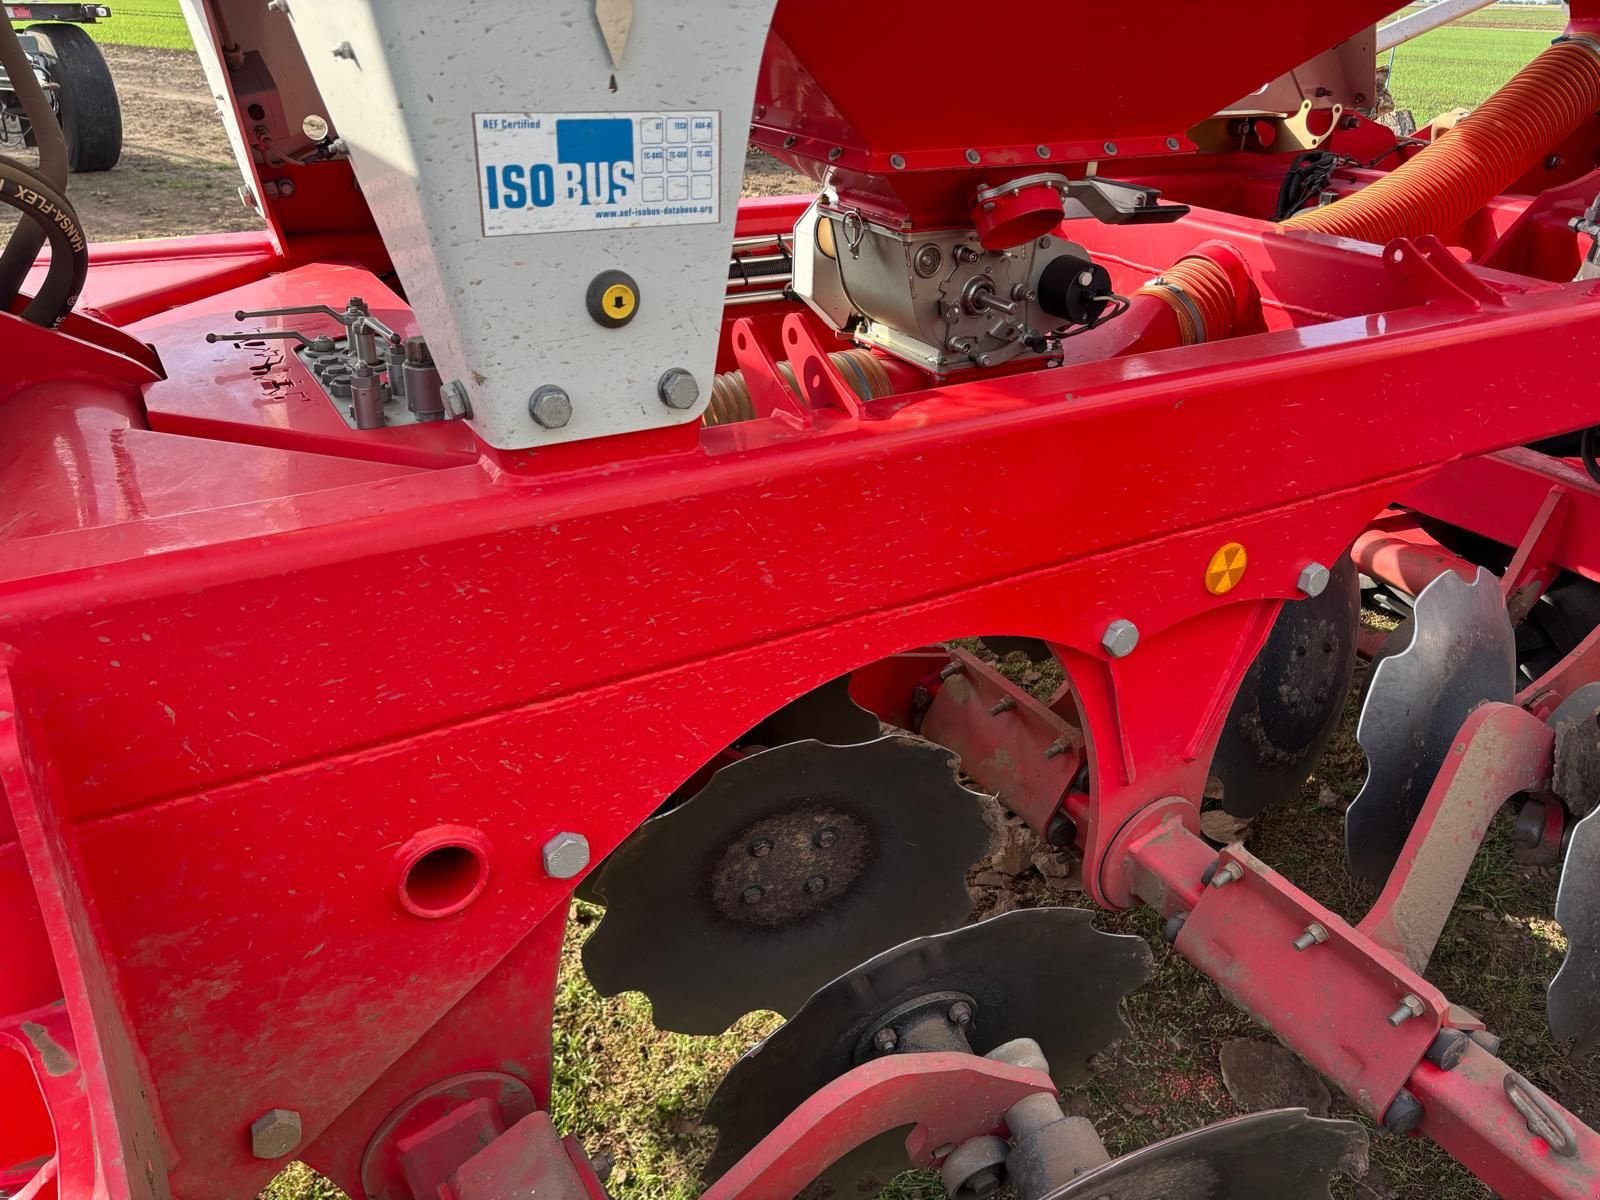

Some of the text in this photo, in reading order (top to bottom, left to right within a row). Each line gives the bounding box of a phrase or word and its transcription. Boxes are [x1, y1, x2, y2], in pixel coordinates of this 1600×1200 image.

[483, 119, 541, 129] AEF Certified
[485, 160, 634, 209] ISOBUS
[14, 184, 84, 253] HANSA-FLEX
[595, 205, 713, 218] www.aef-isobus-database.org
